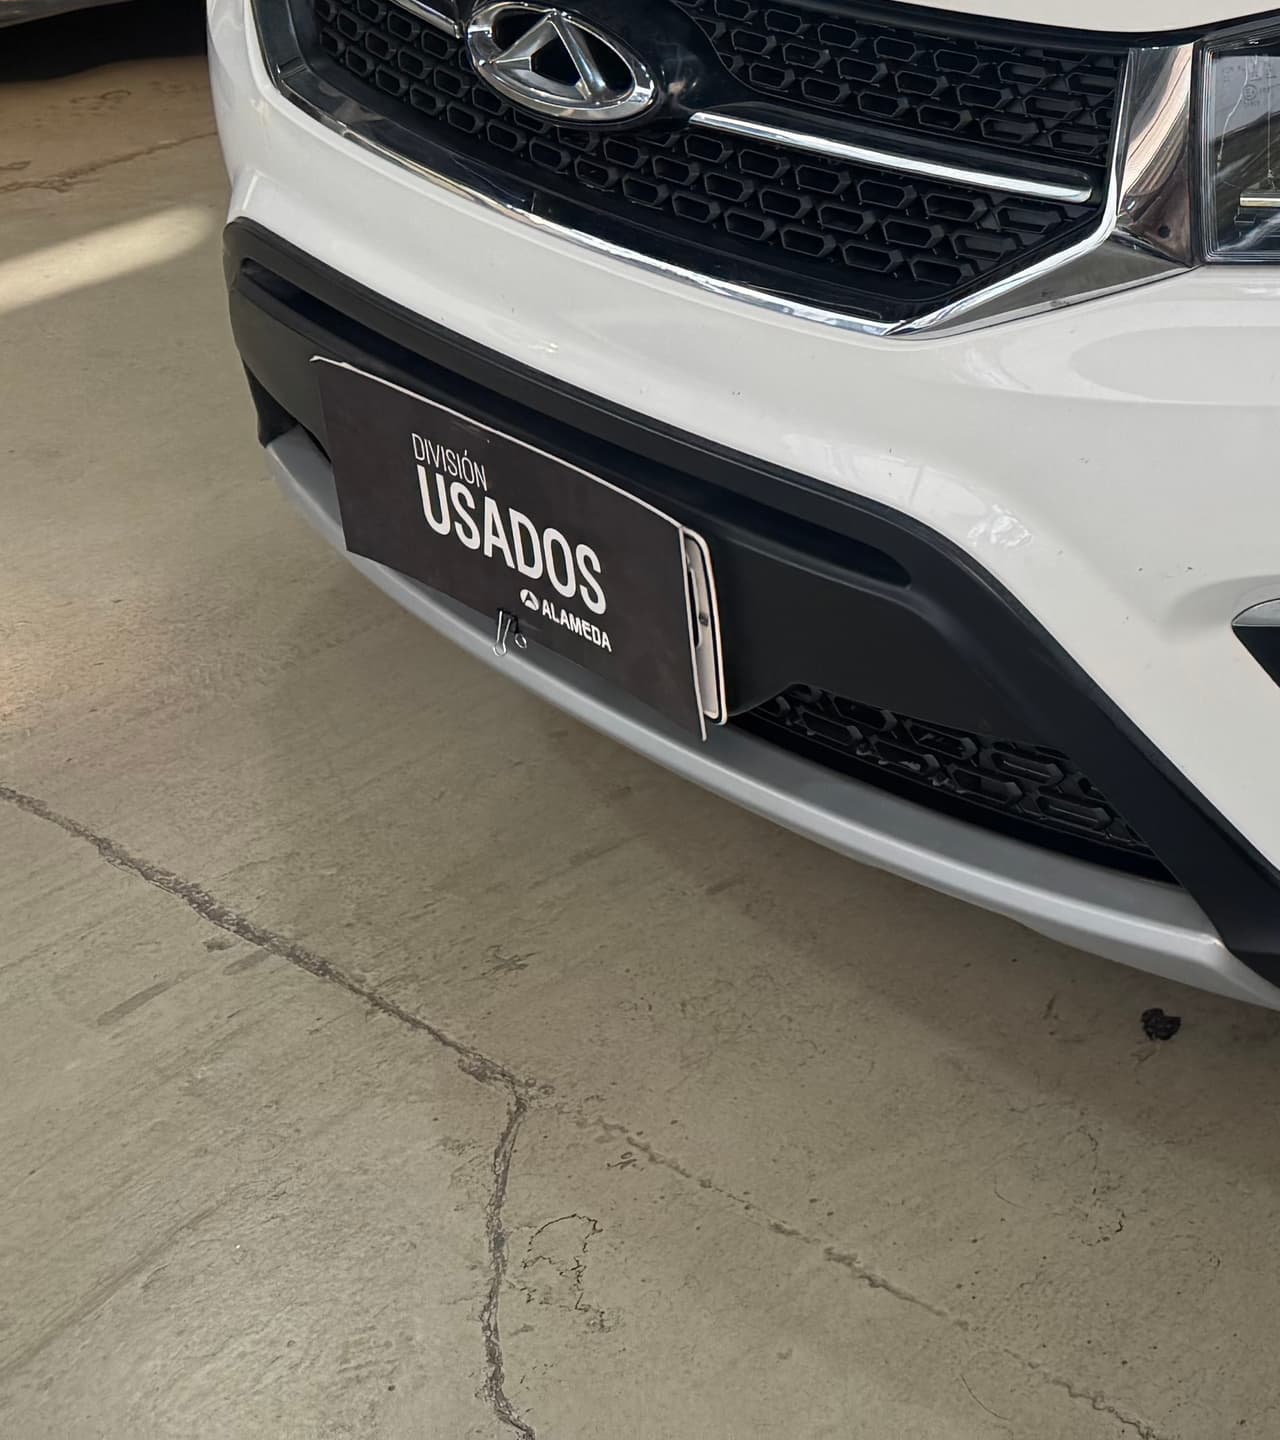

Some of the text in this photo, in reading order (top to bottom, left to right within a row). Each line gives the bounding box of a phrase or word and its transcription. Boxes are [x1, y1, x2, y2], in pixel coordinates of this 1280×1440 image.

[411, 432, 488, 491] DIVISIÓN
[416, 465, 607, 615] USADOS
[541, 598, 613, 653] ALAMEDA
